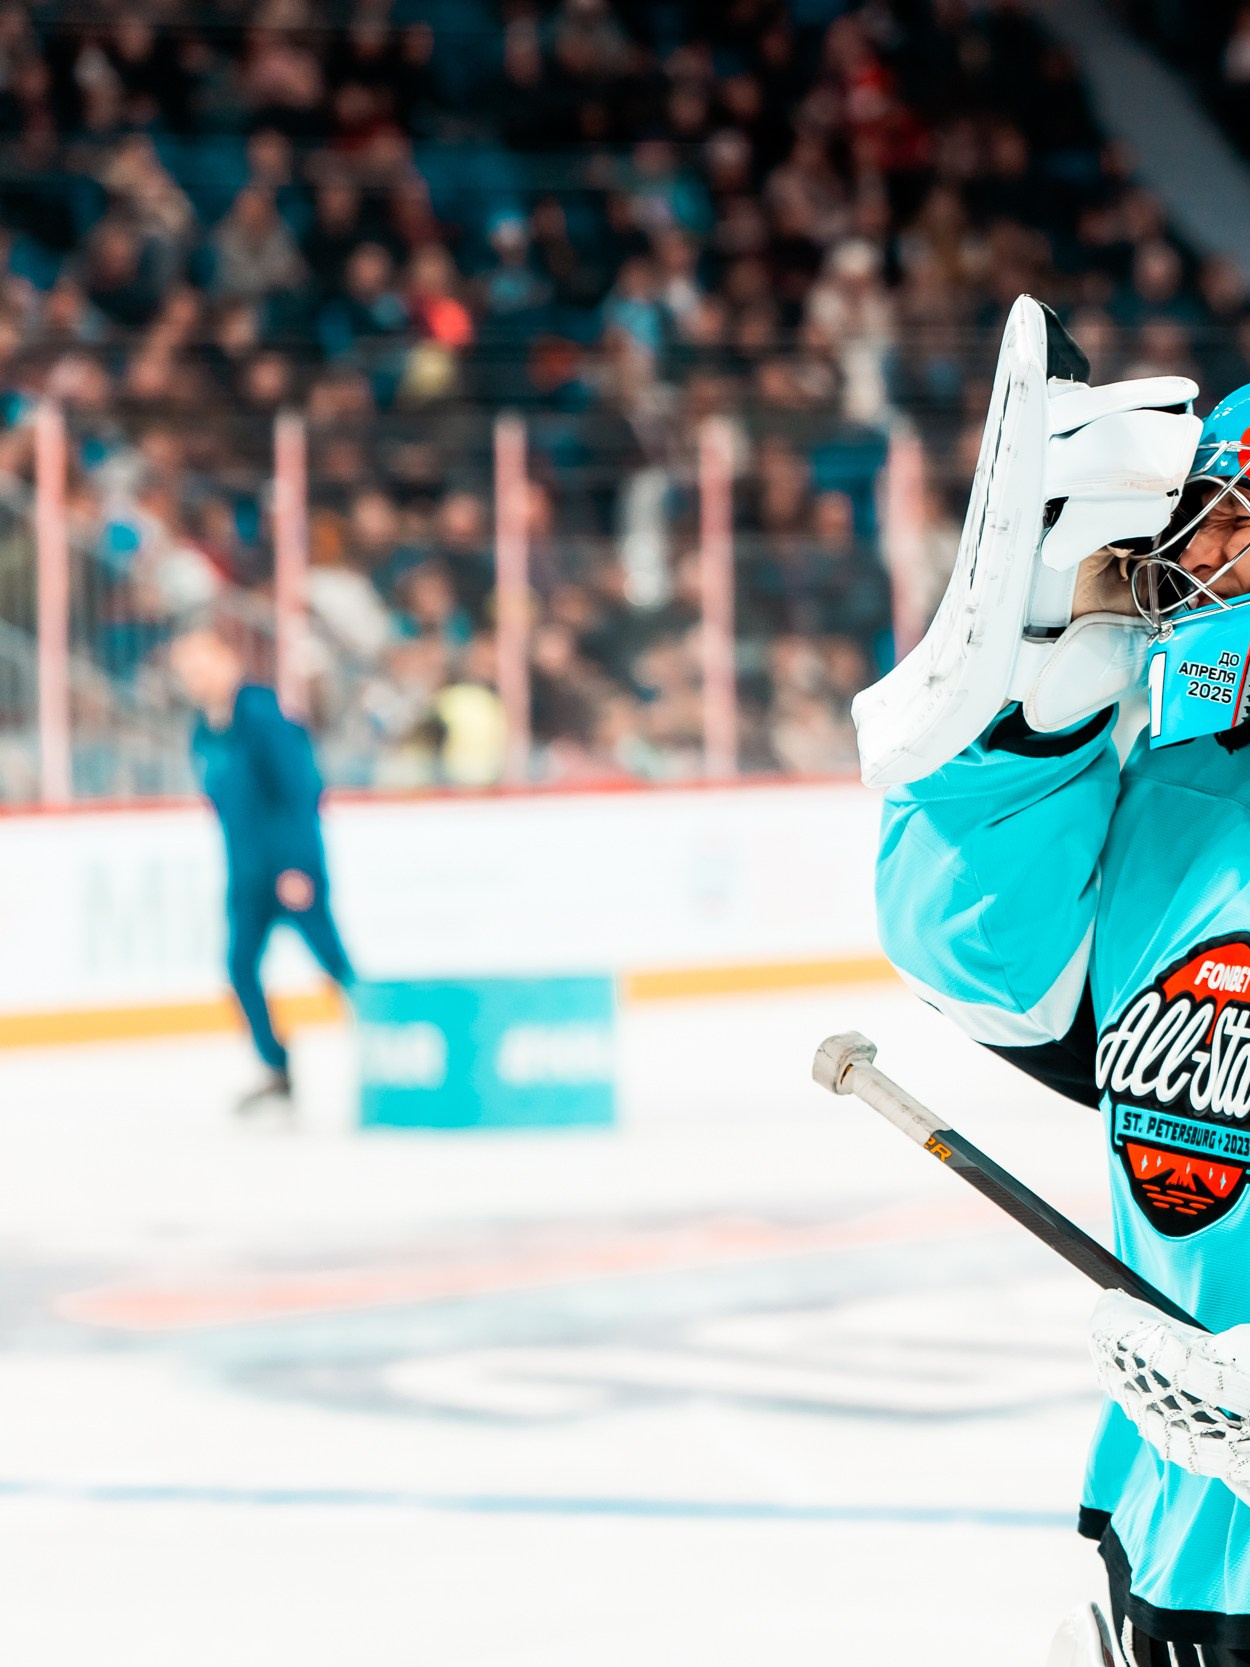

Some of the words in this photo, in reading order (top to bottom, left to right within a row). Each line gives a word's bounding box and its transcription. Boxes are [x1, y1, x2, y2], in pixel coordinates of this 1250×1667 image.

[1218, 652, 1240, 667] ДО
[1178, 662, 1236, 684] АПРЕЛЯ
[1148, 651, 1167, 739] 1
[1188, 681, 1233, 703] 2025
[1123, 1111, 1143, 1133] ST.
[1146, 1116, 1216, 1149] PETERSBURG
[1223, 1136, 1250, 1156] 2023
